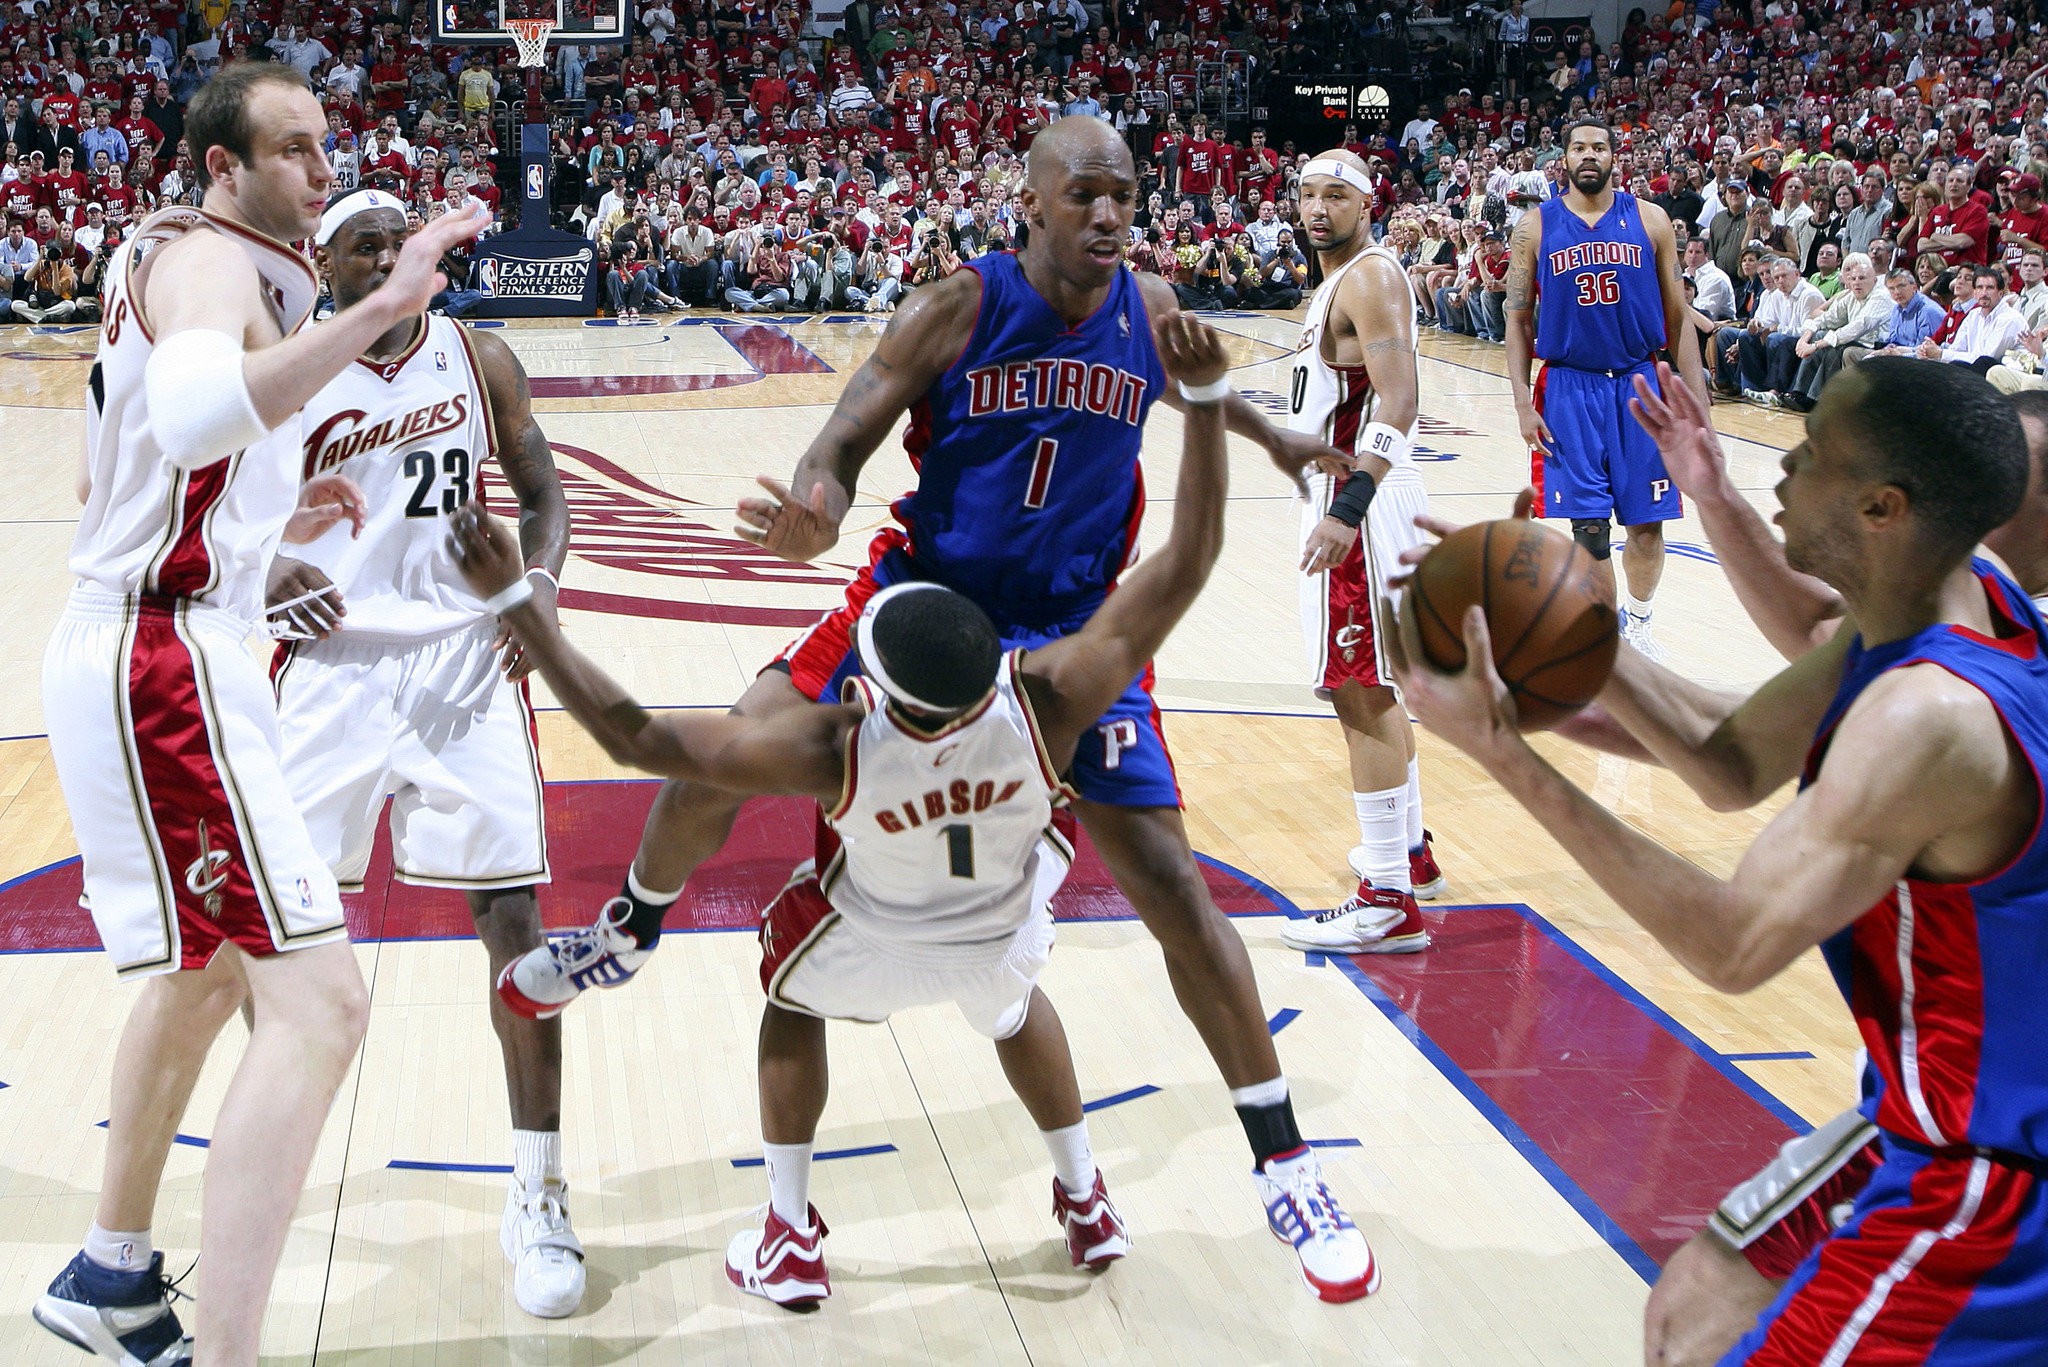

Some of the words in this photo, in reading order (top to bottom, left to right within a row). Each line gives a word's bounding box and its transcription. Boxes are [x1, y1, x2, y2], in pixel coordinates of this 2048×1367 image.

[1566, 34, 1580, 43] TN
[1295, 85, 1313, 96] Key
[1315, 85, 1348, 94] Private
[1323, 97, 1348, 105] Bank
[1192, 152, 1208, 161] BEAT
[13, 195, 31, 204] BEAT
[106, 199, 124, 209] BEAT
[1549, 242, 1642, 276] DETROIT
[500, 262, 590, 276] EASTERN
[498, 285, 548, 294] FINALS
[550, 285, 585, 294] 2007
[499, 277, 587, 285] CONFERENCE
[1575, 270, 1620, 306] 36
[382, 363, 398, 378] C
[966, 358, 1147, 427] DETROIT
[303, 394, 467, 482] CAVALIERS
[1373, 433, 1392, 452] 90
[1024, 437, 1059, 509] 1
[404, 448, 470, 519] 23
[1651, 479, 1669, 501] P
[1098, 719, 1138, 770] P
[874, 779, 1024, 834] GIBSON
[936, 824, 976, 880] 1
